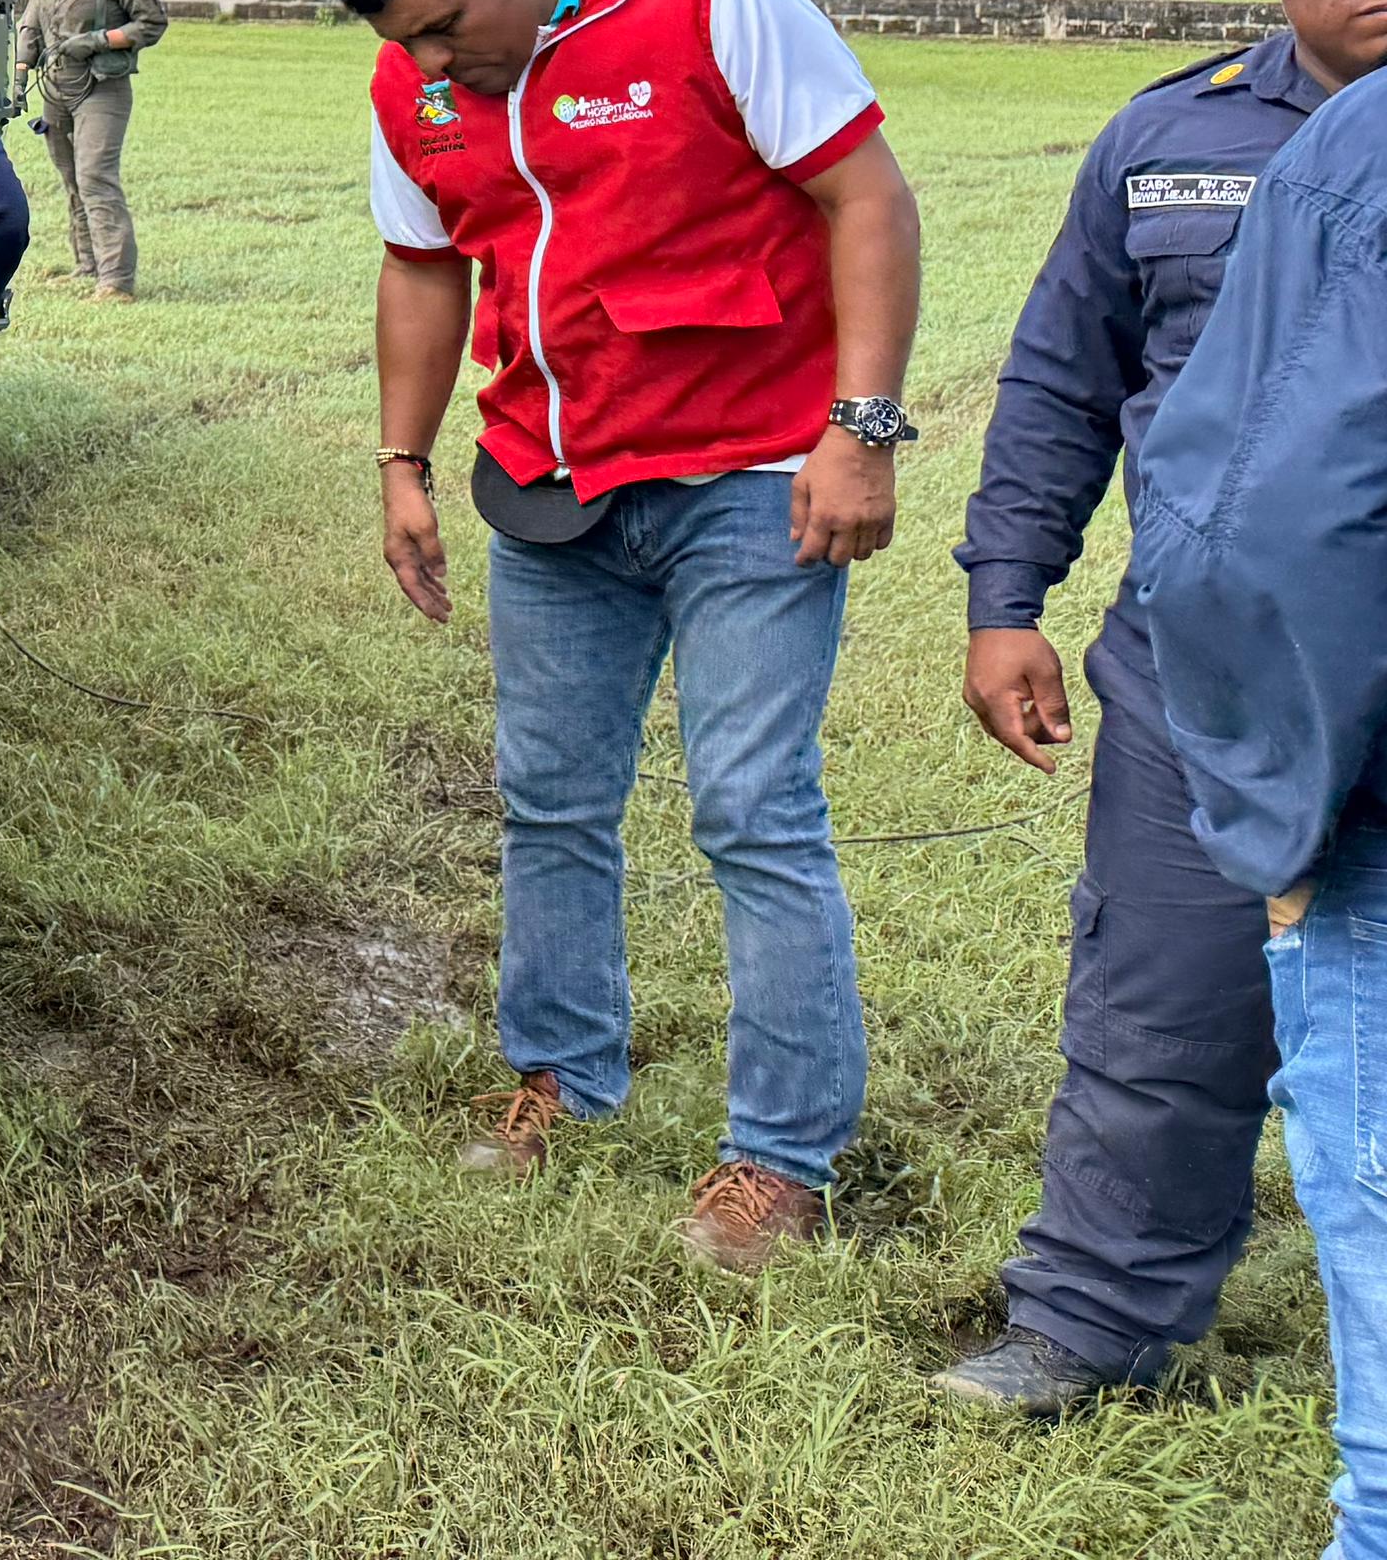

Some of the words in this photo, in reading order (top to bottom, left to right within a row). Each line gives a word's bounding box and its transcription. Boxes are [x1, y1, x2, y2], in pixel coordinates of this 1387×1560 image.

[587, 101, 638, 118] HOSPITAL
[1138, 180, 1174, 191] CABO
[1198, 180, 1218, 190] RH
